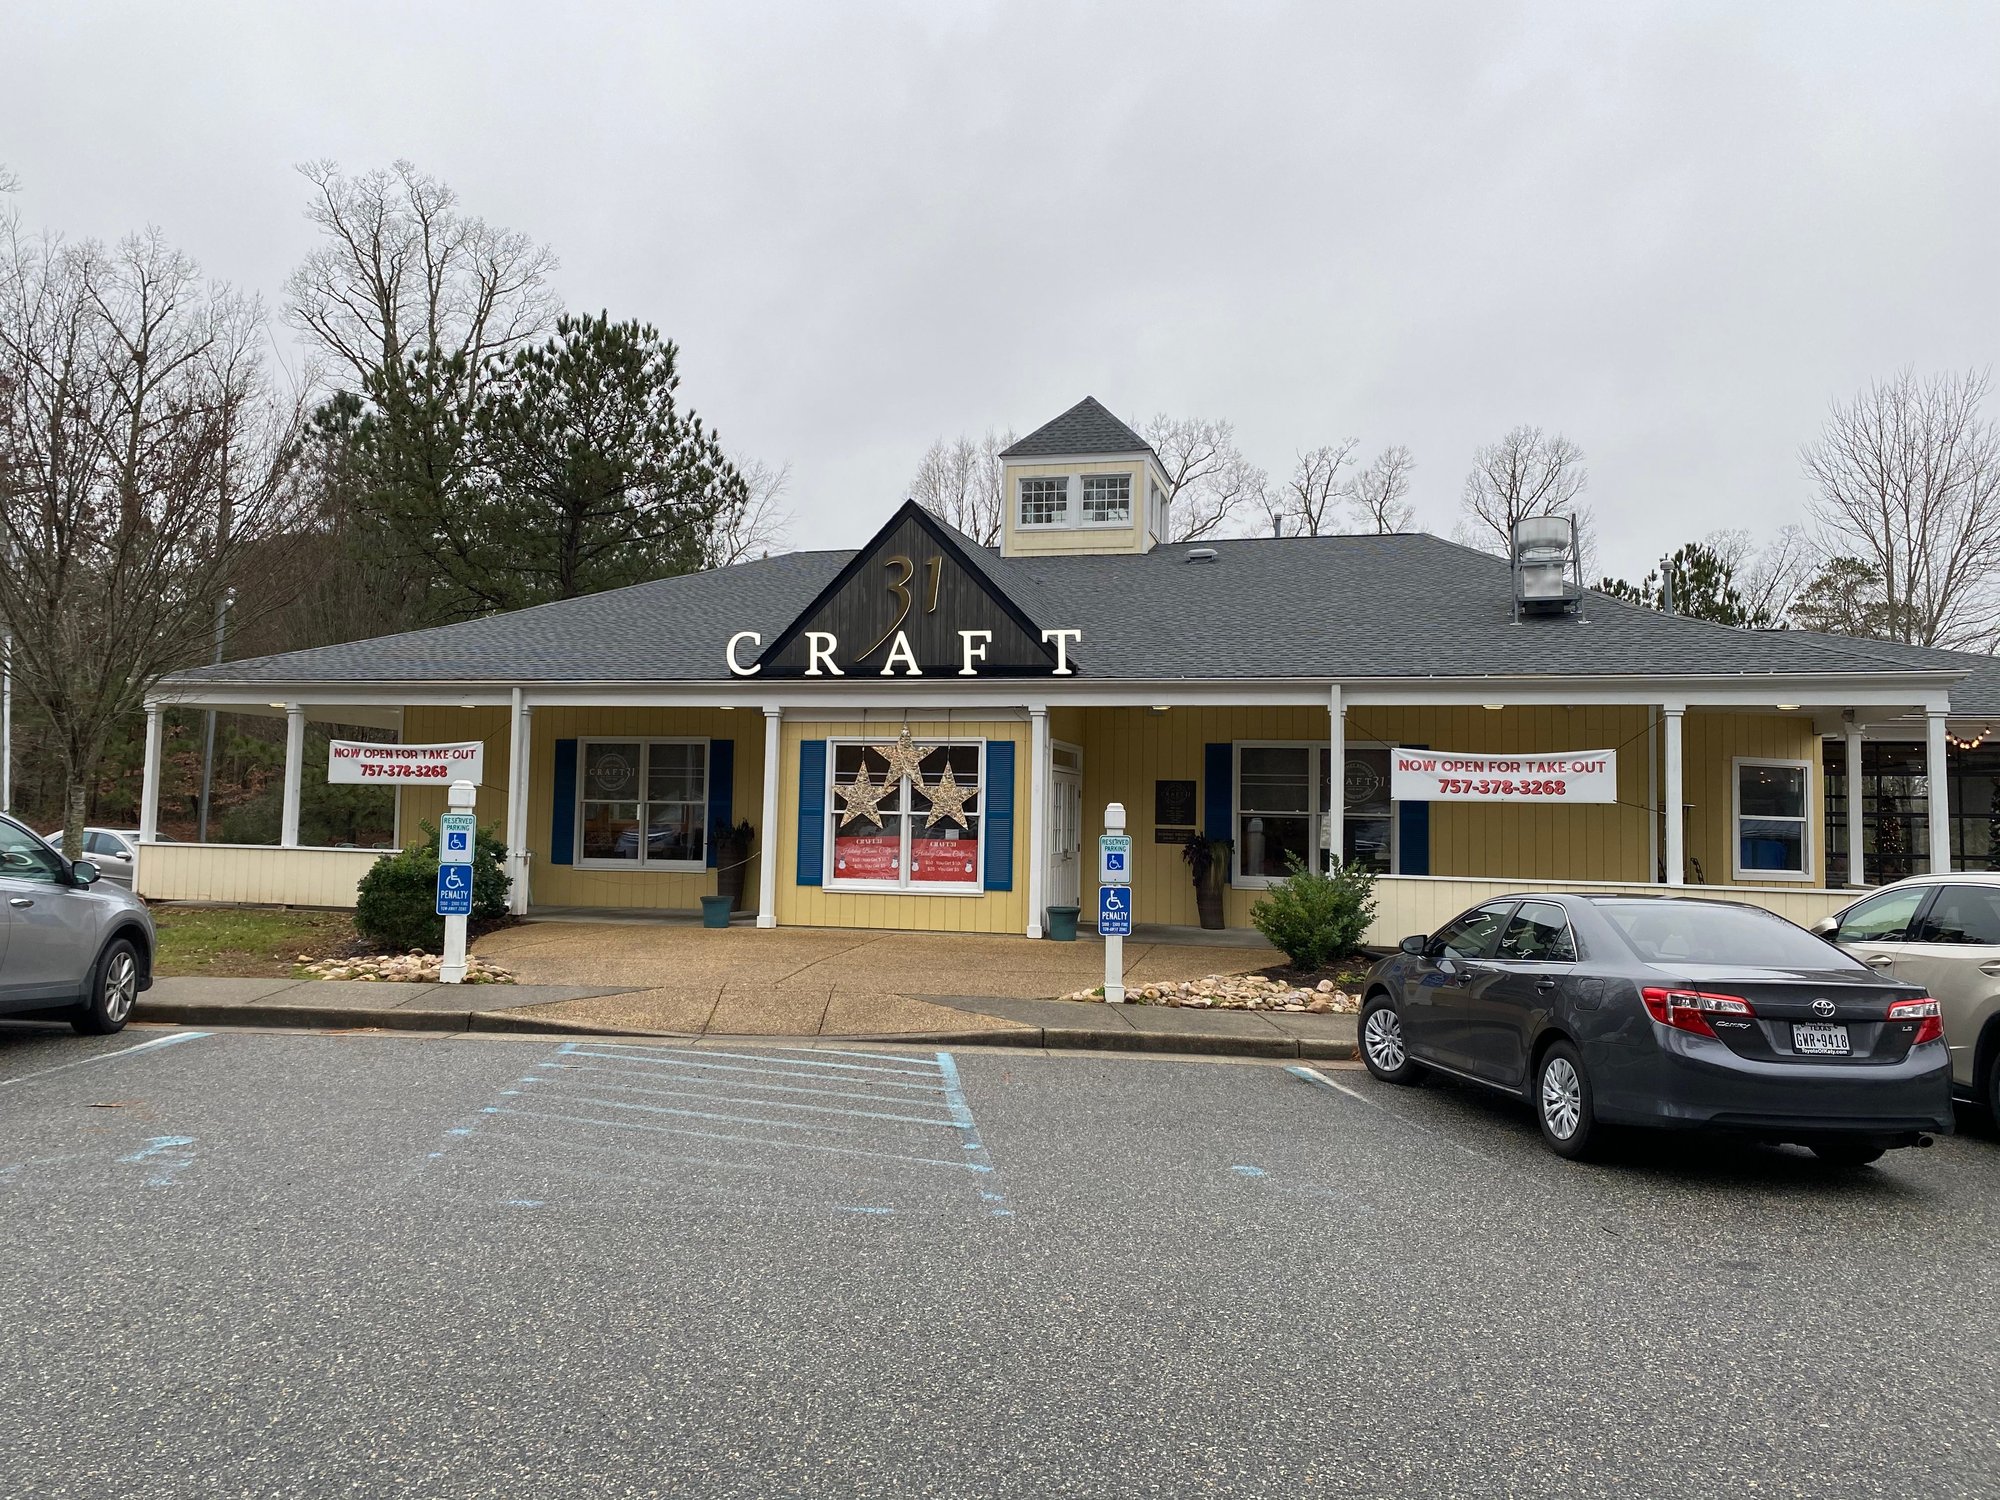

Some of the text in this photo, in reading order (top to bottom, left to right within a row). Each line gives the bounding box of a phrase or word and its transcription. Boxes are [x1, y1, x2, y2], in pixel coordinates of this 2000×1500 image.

[856, 555, 942, 661] 31
[725, 629, 1082, 676] CRAFT
[334, 748, 361, 759] NOW
[364, 749, 393, 759] OPEN
[396, 749, 418, 759] FOR
[360, 764, 448, 778] 757-378-3268
[1398, 760, 1437, 772] NOW
[1441, 760, 1484, 773] OPEN
[1488, 761, 1520, 773] FOR
[1438, 779, 1566, 795] 757-378-3268
[444, 817, 472, 825] RESERVED
[1102, 838, 1129, 846] RESERVED
[440, 890, 469, 899] PENALTY
[1102, 911, 1128, 920] PENALTY
